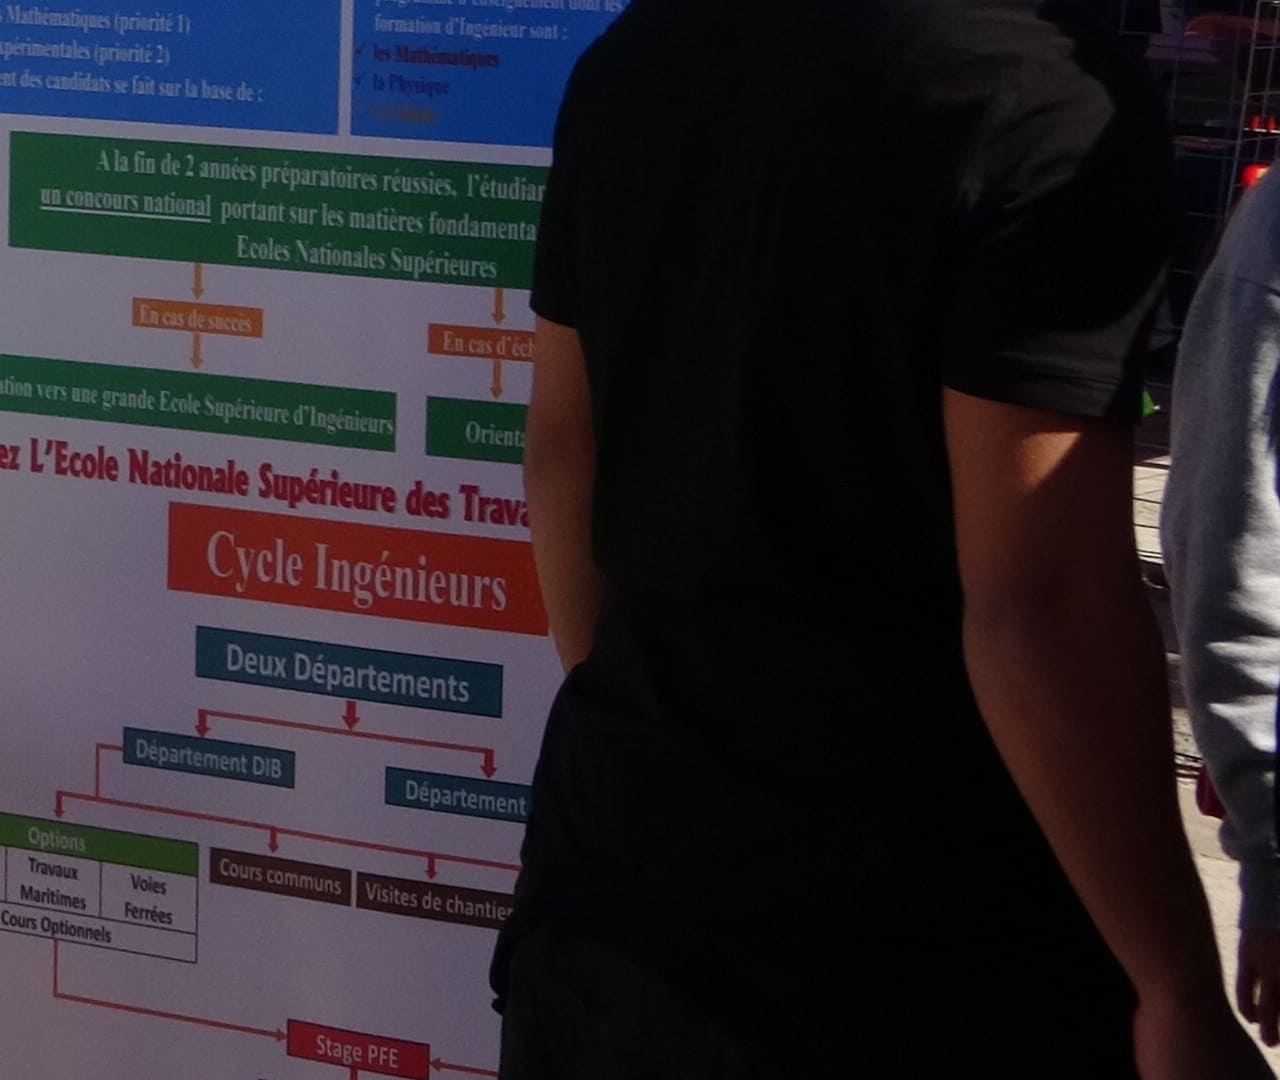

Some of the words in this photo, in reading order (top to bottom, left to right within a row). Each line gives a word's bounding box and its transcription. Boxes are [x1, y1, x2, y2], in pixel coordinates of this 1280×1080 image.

[236, 235, 290, 261] Ecoles
[296, 239, 385, 270] Nationales
[390, 246, 497, 280] Supérieures
[128, 448, 249, 496] Nationale
[259, 463, 396, 516] Supérieure
[406, 481, 450, 519] des
[459, 484, 529, 527] Trava
[206, 528, 304, 591] Cycle
[316, 539, 507, 612] Ingénieurs
[227, 643, 287, 680] Deux
[294, 652, 470, 703] Départements
[136, 739, 247, 776] Département
[252, 755, 283, 780] DIB
[405, 780, 526, 817] Département
[28, 825, 86, 854] Options
[28, 857, 78, 882] Travaux
[131, 872, 166, 897] Voies
[219, 858, 261, 883] Cours
[266, 869, 342, 895] communs
[19, 884, 87, 912] Maritimes
[124, 899, 173, 925] Ferrées
[365, 881, 418, 907] Visites
[422, 890, 441, 911] de
[445, 893, 513, 922] chantier
[1, 909, 37, 932] Cours
[42, 916, 112, 945] Optionnels
[316, 1034, 362, 1065] Stage
[367, 1041, 398, 1069] PFE
